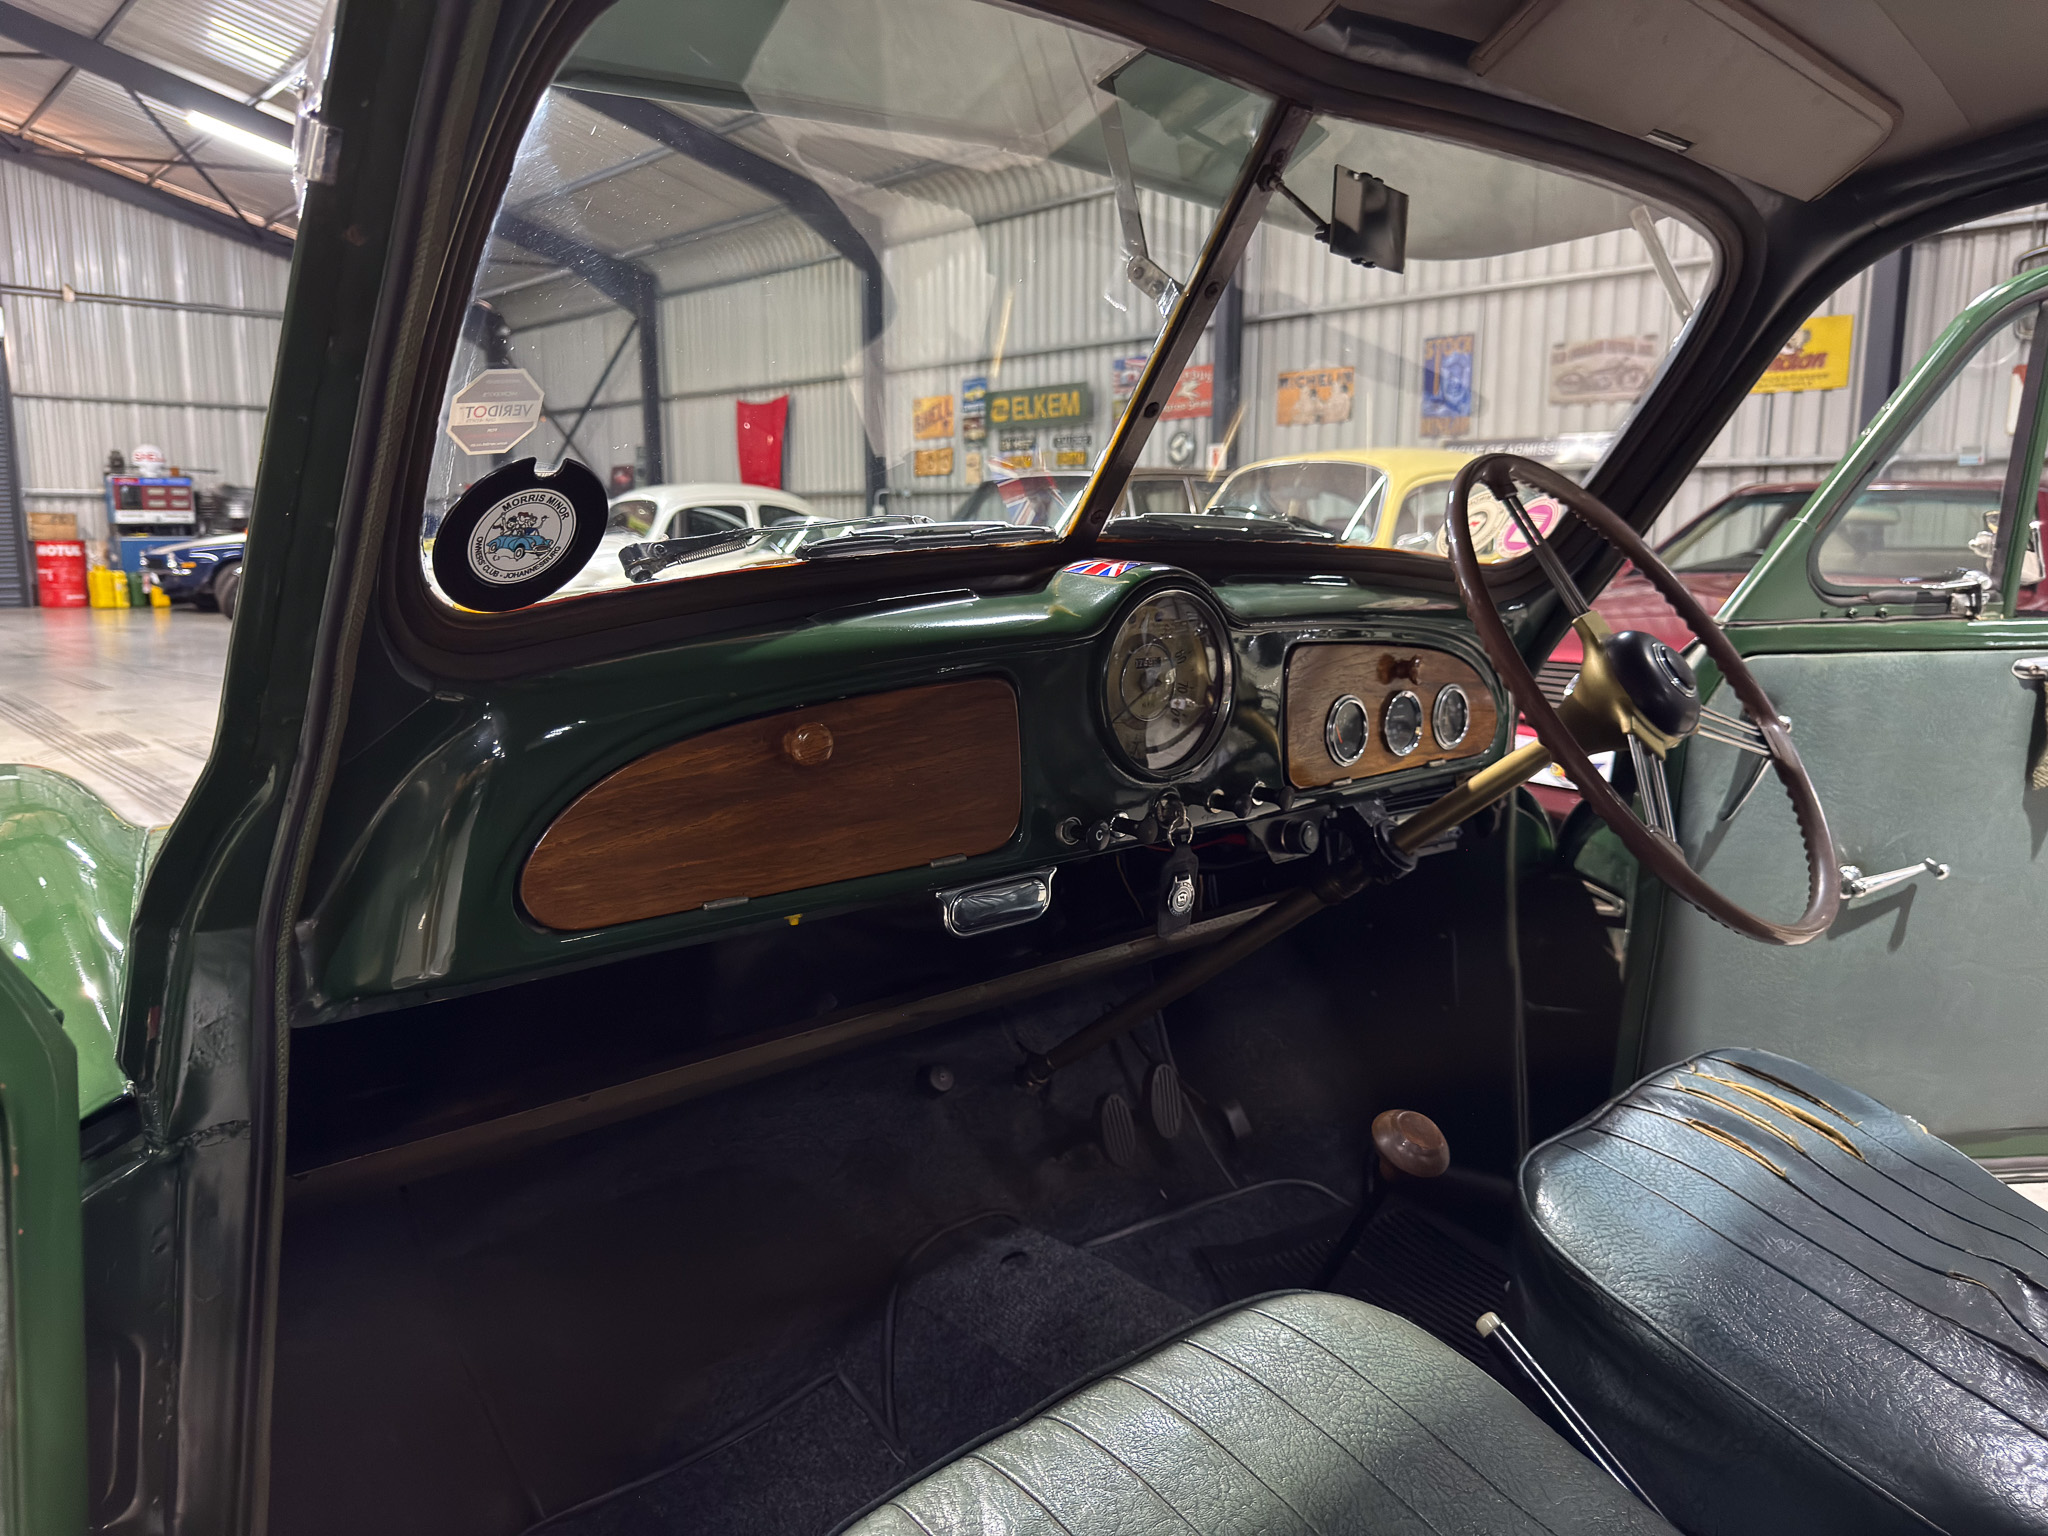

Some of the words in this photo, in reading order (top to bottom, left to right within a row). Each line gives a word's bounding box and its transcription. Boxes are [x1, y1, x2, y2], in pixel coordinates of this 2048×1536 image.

[1012, 390, 1081, 422] ELKEM
[501, 494, 546, 512] MORRIS
[546, 496, 570, 521] MINOR
[482, 563, 501, 578] CLUB
[503, 546, 562, 579] JOHANNESBURG
[1095, 829, 1103, 841] C
